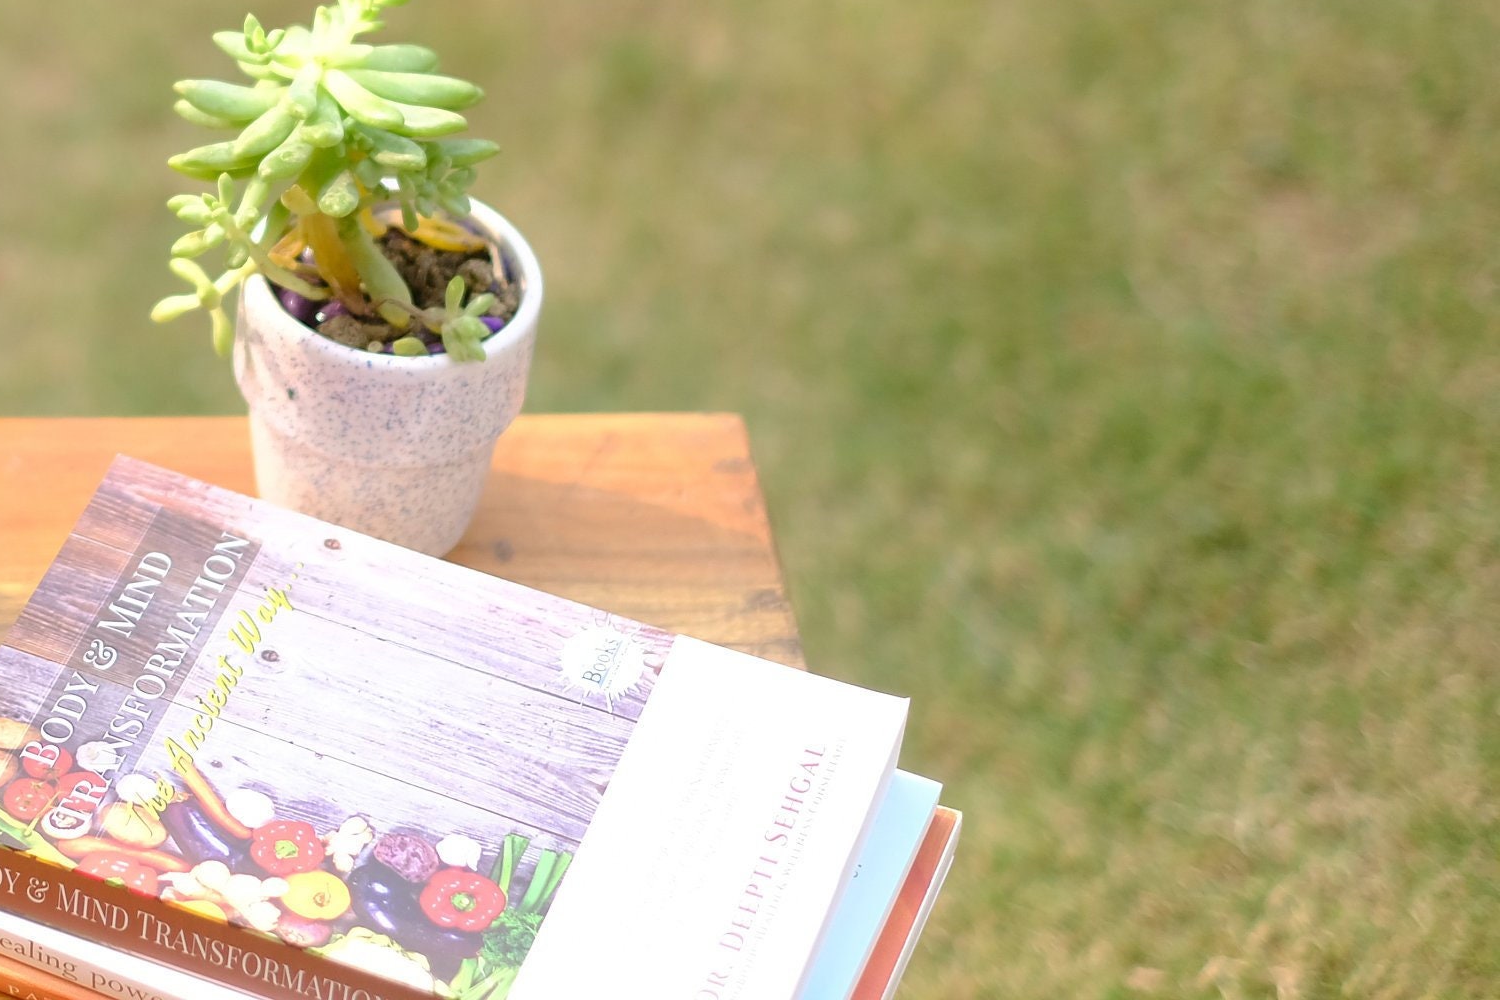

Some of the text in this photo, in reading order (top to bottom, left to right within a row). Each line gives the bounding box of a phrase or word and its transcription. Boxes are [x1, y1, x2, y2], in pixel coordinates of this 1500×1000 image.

[19, 551, 173, 769] BODY & MIND
[51, 531, 251, 822] TRANSFORMATION
[124, 777, 176, 837] The
[162, 654, 244, 775] Ancient
[26, 876, 50, 903] &
[56, 882, 129, 931] MIND
[137, 910, 390, 1000] TRANSFORMATI
[719, 857, 778, 952] DEEPTI
[764, 744, 826, 847] SEHGAL
